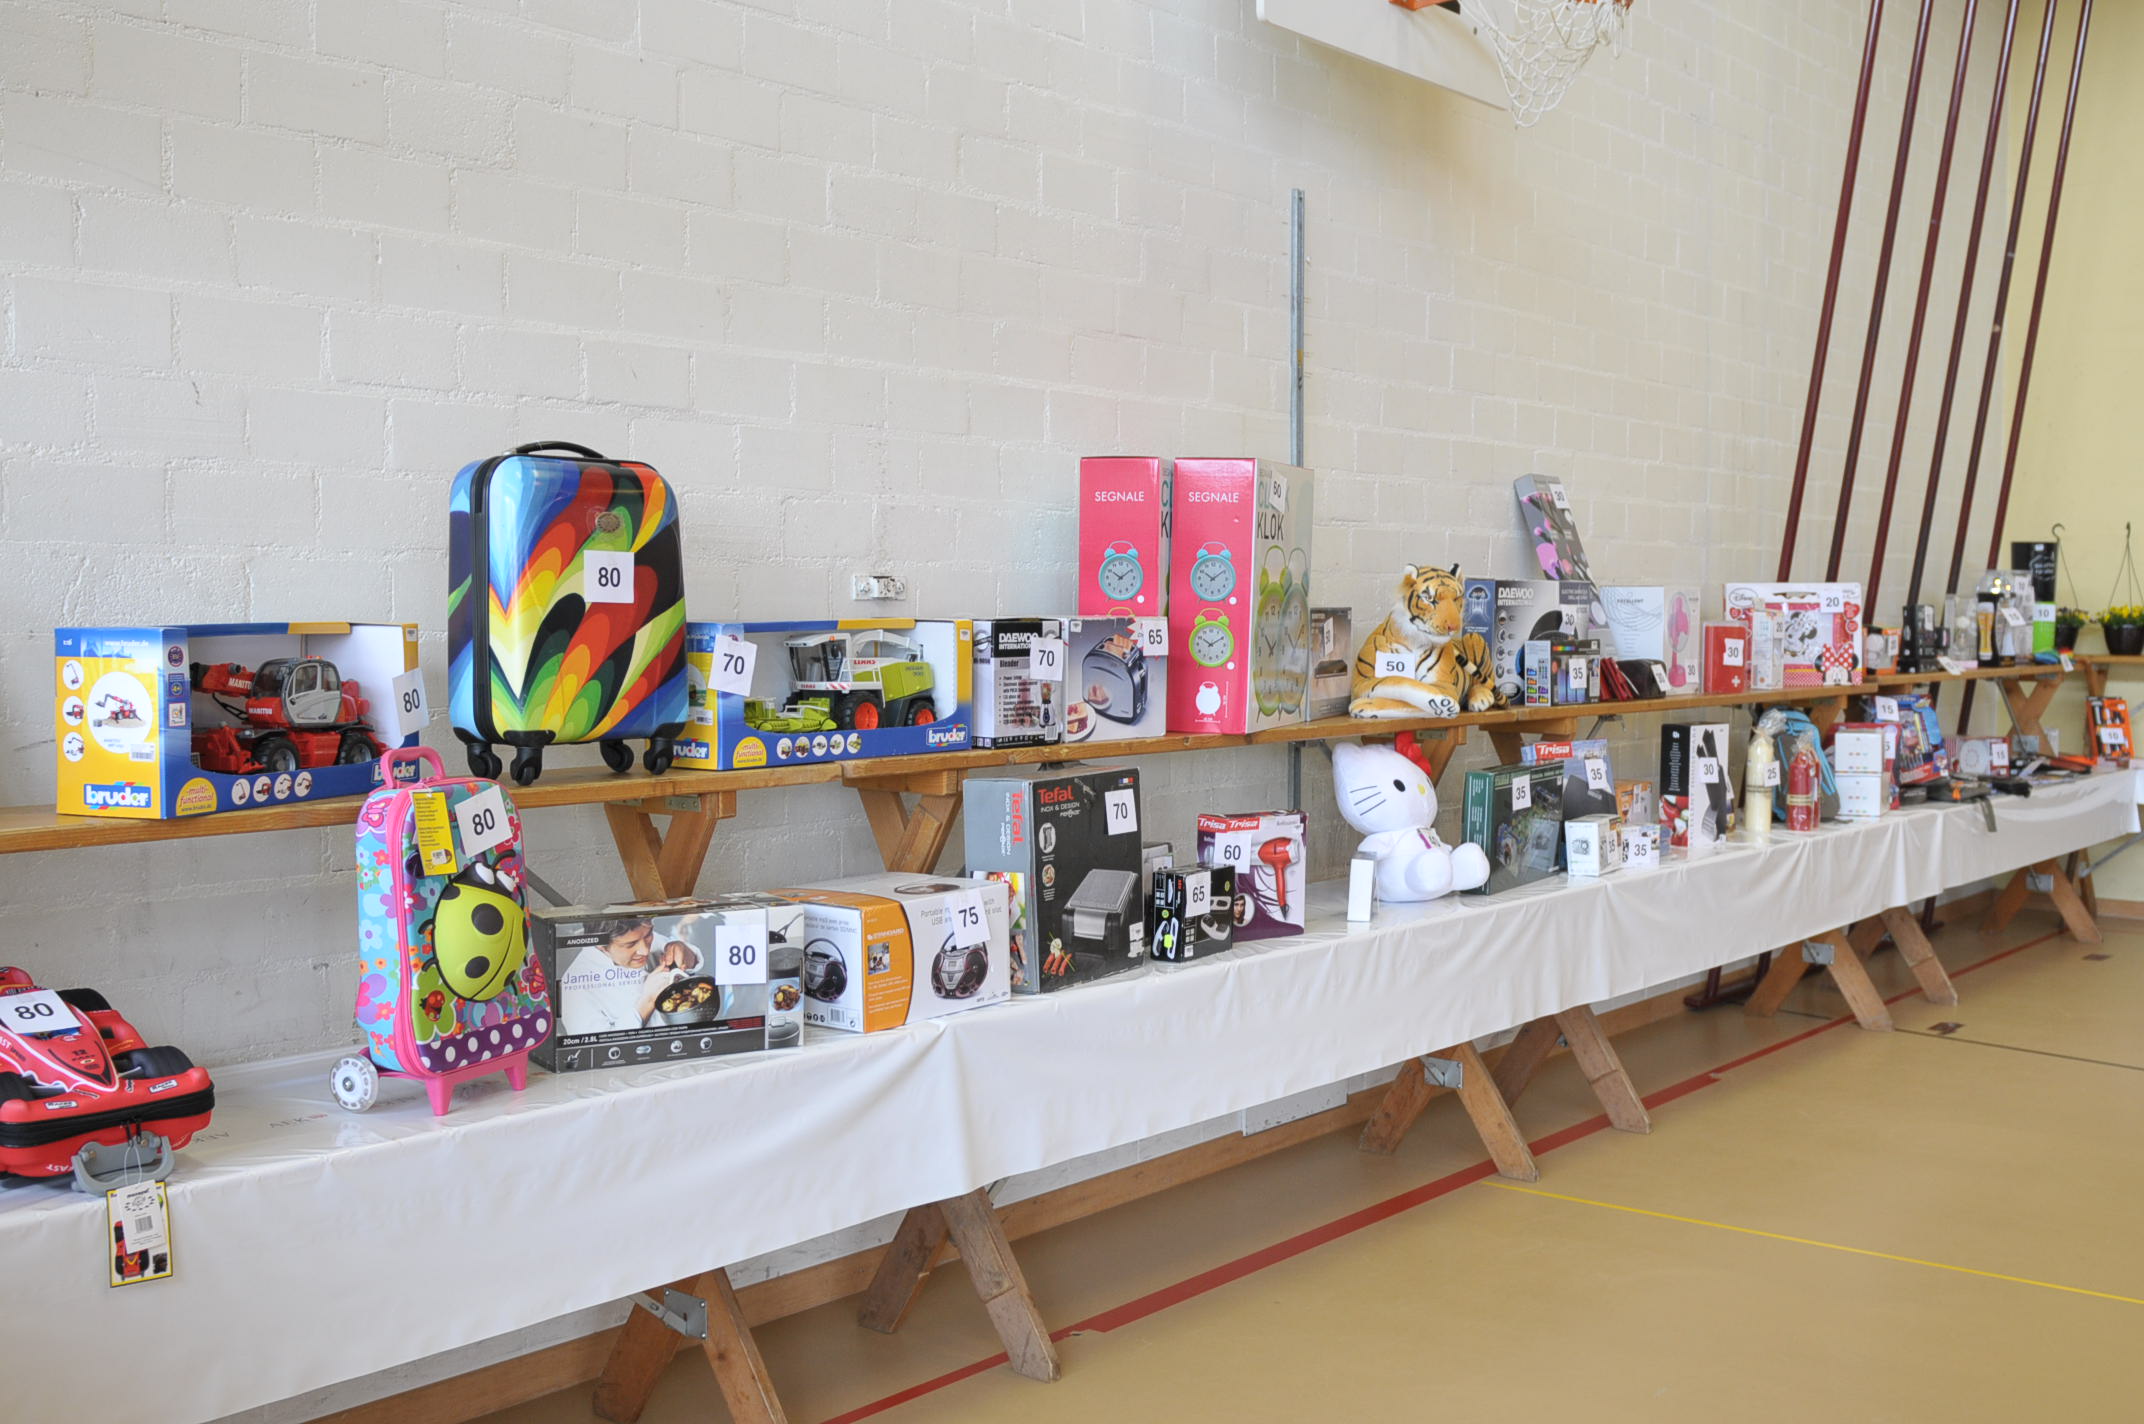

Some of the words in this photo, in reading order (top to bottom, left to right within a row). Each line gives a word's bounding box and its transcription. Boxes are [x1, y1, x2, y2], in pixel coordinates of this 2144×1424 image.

[1094, 490, 1145, 503] SEGNALE
[1187, 490, 1240, 503] SEGNALE
[1257, 511, 1284, 541] KLOK
[597, 566, 622, 589] 80
[1498, 587, 1535, 599] DAEWOO
[1826, 596, 1840, 608] 20
[1564, 613, 1575, 627] 30
[2037, 608, 2050, 618] 10
[1148, 629, 1163, 645] 65
[1038, 649, 1055, 667] 70
[1727, 646, 1740, 658] 30
[723, 652, 745, 675] 70
[1385, 660, 1405, 673] 50
[1572, 667, 1584, 681] 35
[403, 688, 420, 713] 80
[1882, 704, 1894, 714] 15
[928, 729, 968, 743] bruder
[673, 742, 708, 758] ruder
[1537, 744, 1571, 755] Trisa
[1590, 767, 1603, 781] 35
[1703, 763, 1715, 776] 30
[1767, 767, 1777, 780] 25
[87, 784, 149, 807] bruder
[1037, 785, 1075, 804] Tefal
[1515, 786, 1527, 801] 35
[1061, 801, 1080, 810] DESIGN
[1113, 801, 1129, 819] 70
[472, 808, 496, 836] 80
[1011, 788, 1025, 847] Tefal
[1199, 817, 1227, 830] Trisa
[1230, 819, 1259, 829] Trisa
[1223, 844, 1242, 861] 60
[1608, 839, 1616, 853] 35
[1633, 843, 1648, 857] 35
[1192, 885, 1205, 904] 65
[958, 906, 979, 928] 75
[566, 937, 600, 946] ANODIZED
[728, 944, 756, 966] 80
[563, 970, 601, 985] Jamie
[604, 967, 642, 981] Oliver
[564, 982, 616, 991] PROFESSIONAL
[14, 1002, 54, 1020] 80
